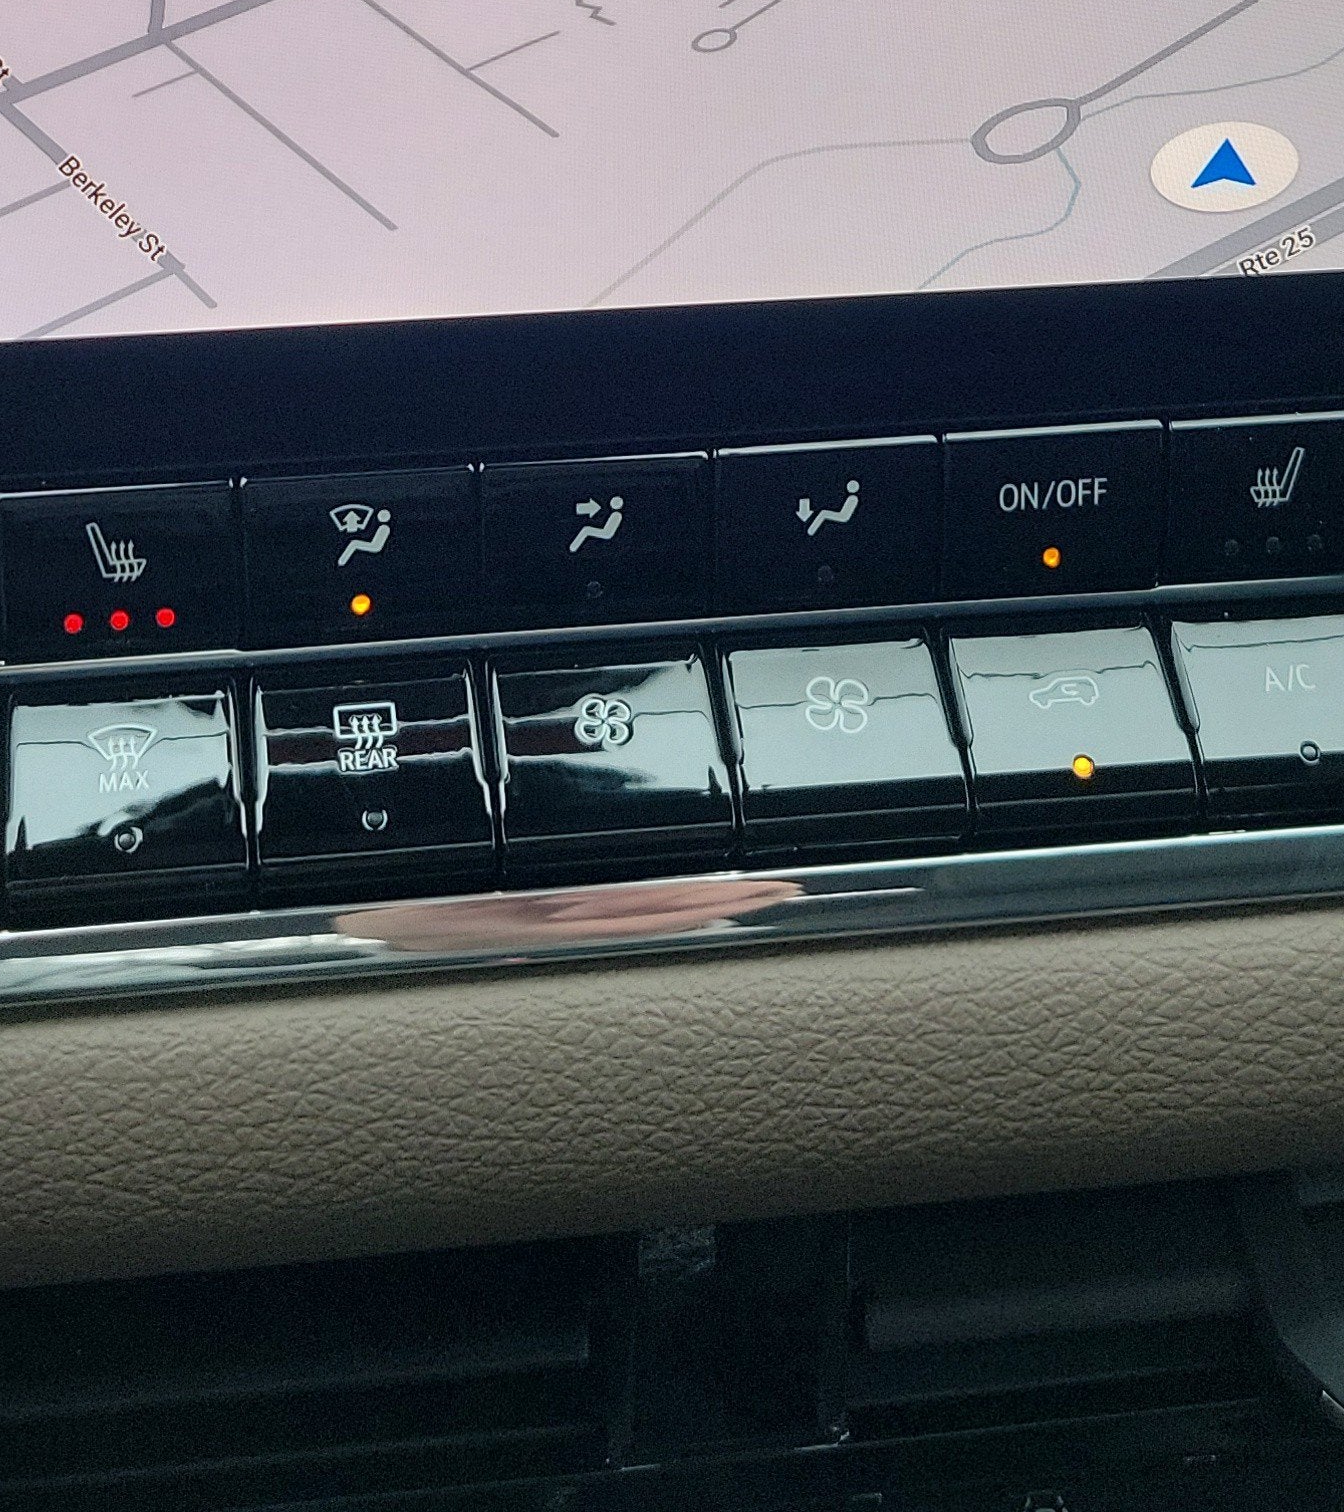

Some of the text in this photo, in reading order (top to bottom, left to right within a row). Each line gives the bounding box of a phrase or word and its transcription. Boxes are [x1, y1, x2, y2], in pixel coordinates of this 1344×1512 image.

[58, 154, 167, 263] Berkeley St
[1239, 228, 1314, 276] Rte 25
[999, 478, 1107, 511] ON/OFF
[1264, 664, 1315, 692] A/C
[341, 748, 397, 771] REAR
[98, 770, 149, 793] MAX
